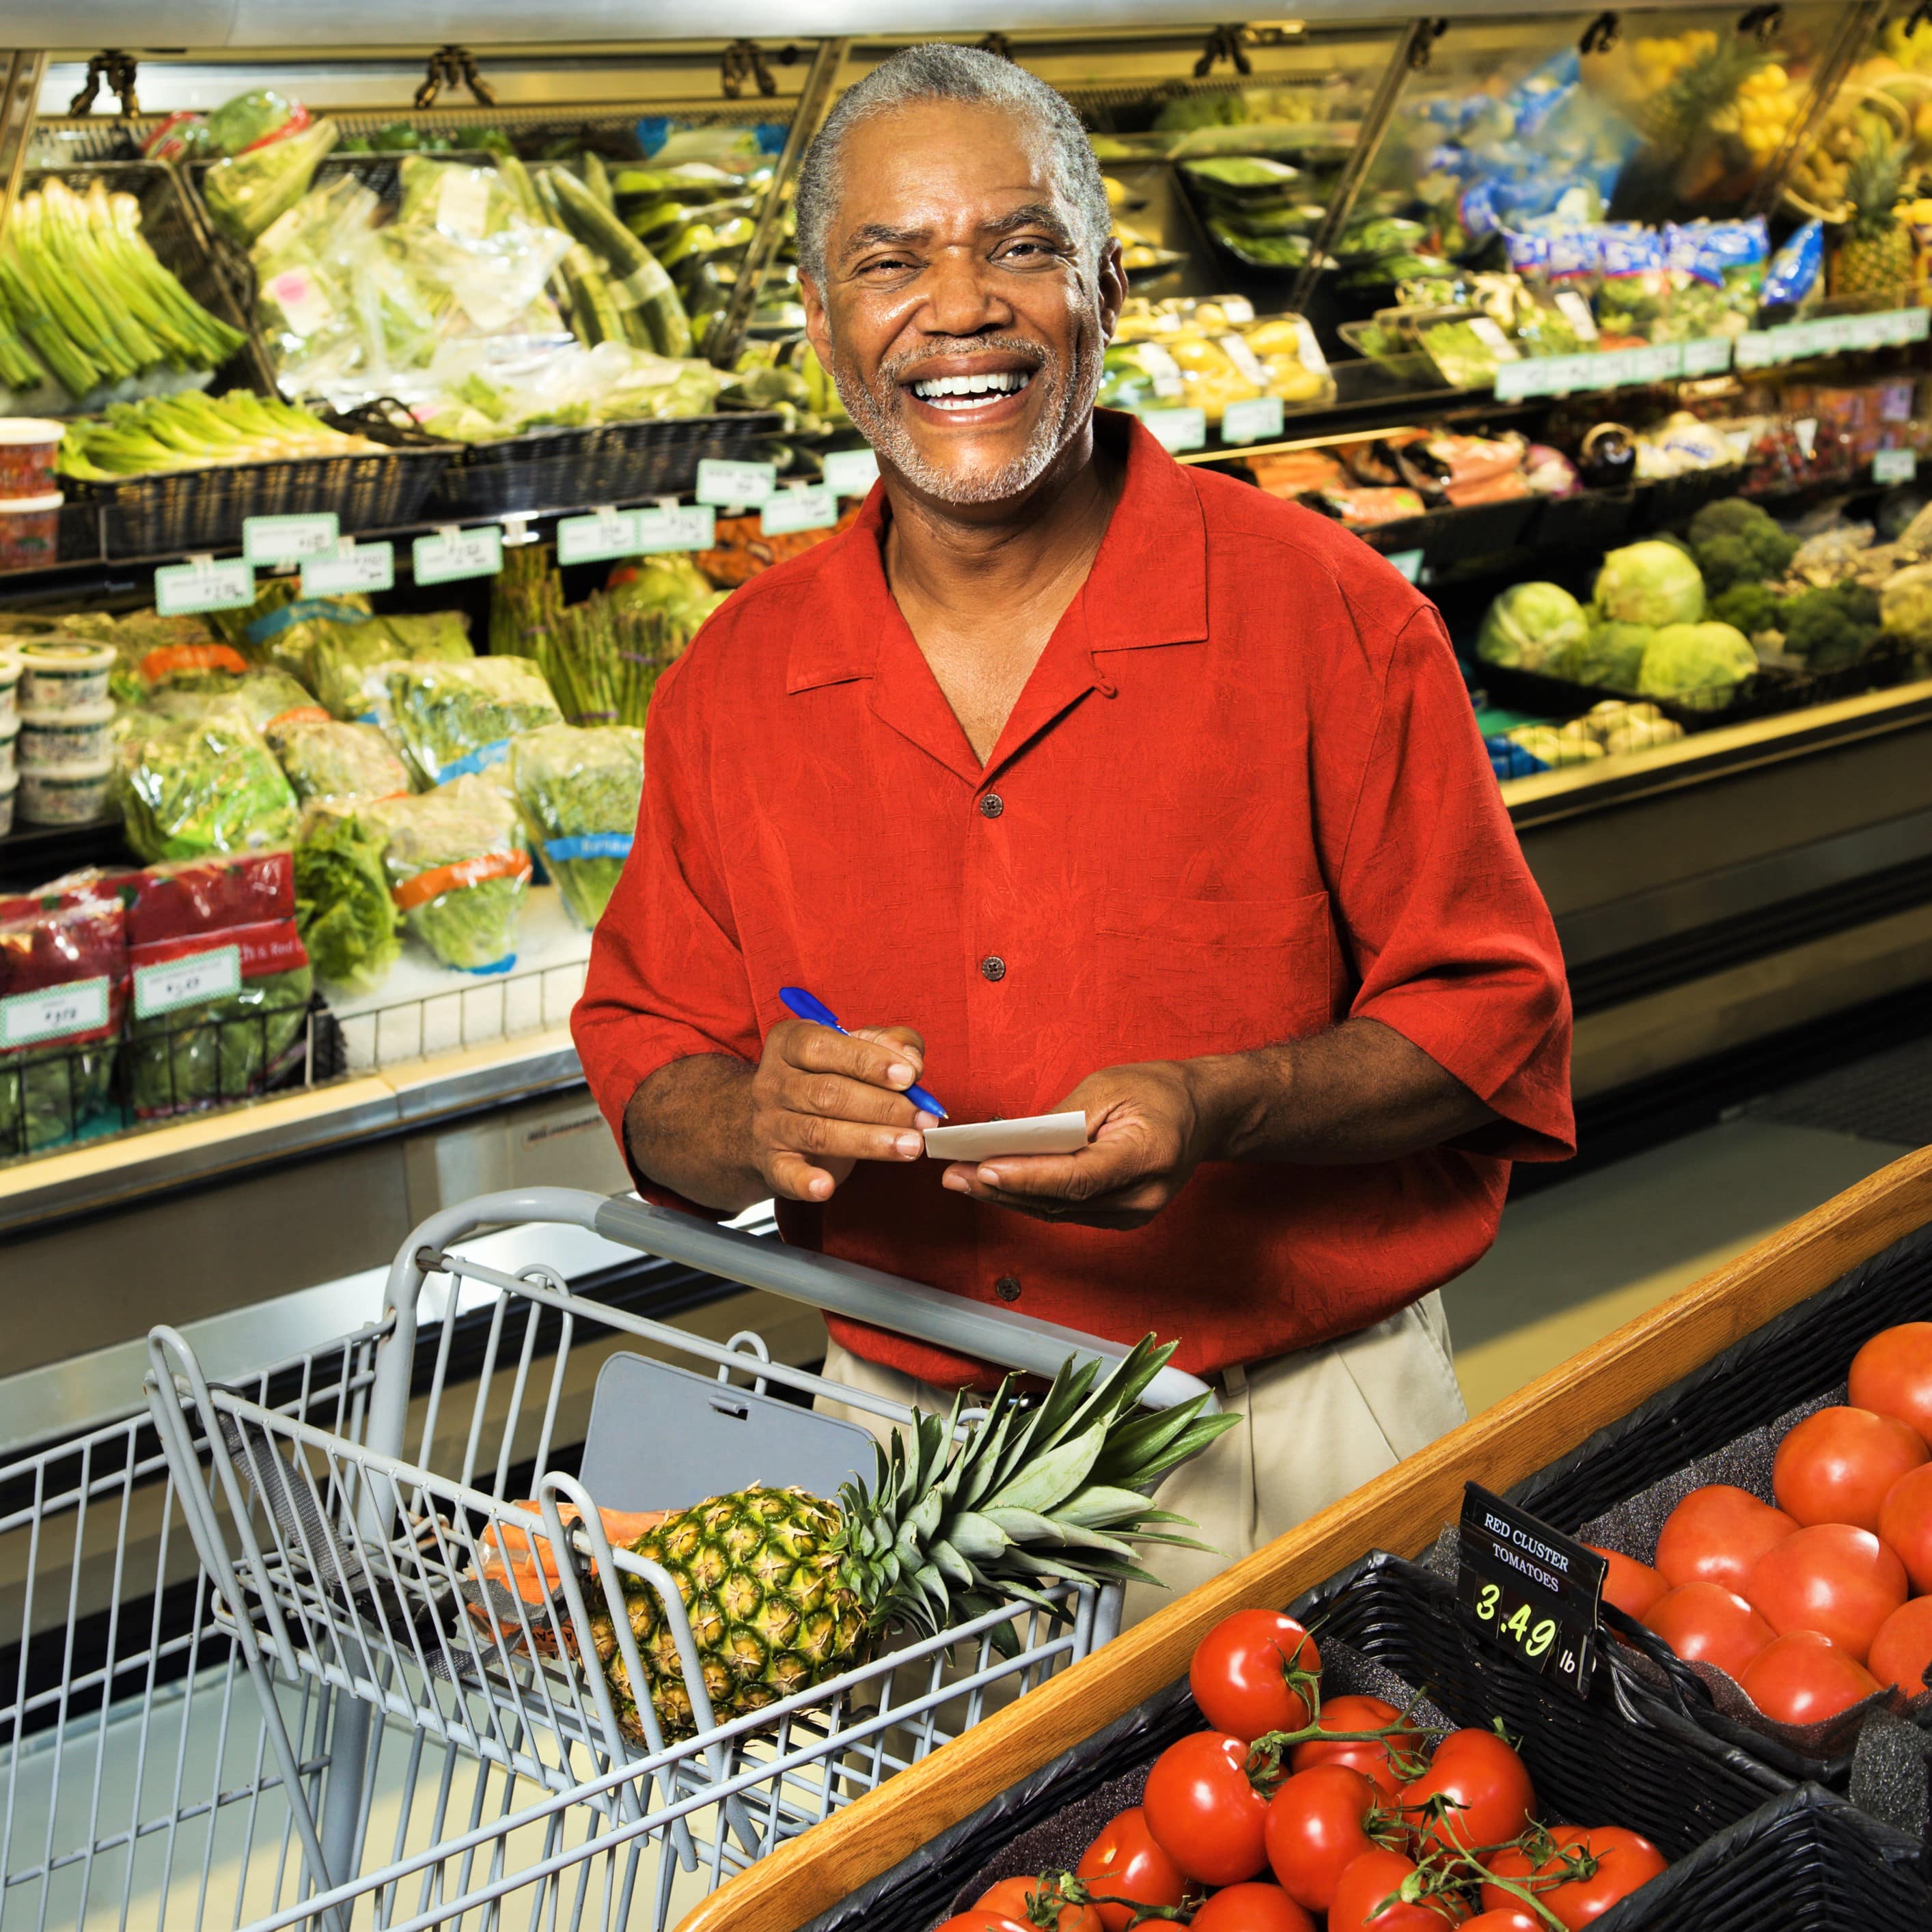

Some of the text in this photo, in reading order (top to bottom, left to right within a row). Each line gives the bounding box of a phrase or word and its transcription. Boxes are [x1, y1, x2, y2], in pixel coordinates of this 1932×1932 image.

[1484, 1513, 1569, 1573] RED CLUSTER
[1493, 1543, 1559, 1592] TOMATOES
[1476, 1584, 1575, 1673] 3.49 lb
